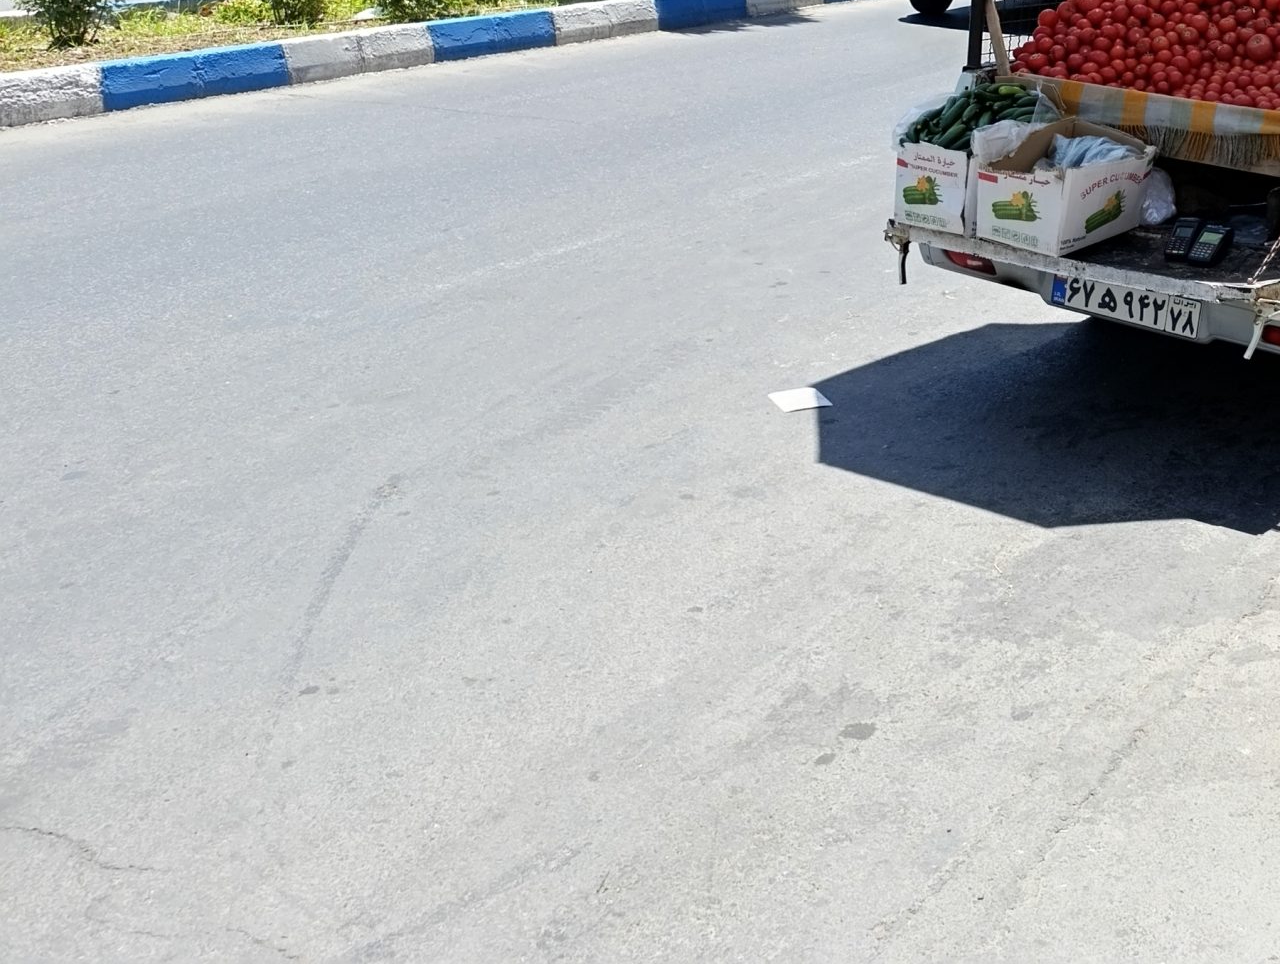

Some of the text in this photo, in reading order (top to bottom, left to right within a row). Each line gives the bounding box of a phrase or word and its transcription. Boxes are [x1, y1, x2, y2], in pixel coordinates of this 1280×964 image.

[1079, 177, 1109, 201] SUPER
[1067, 277, 1095, 308] ۶۷
[1123, 290, 1166, 326] ۹۴۲
[1173, 297, 1197, 309] ایران
[1169, 306, 1195, 336] ۷۸
